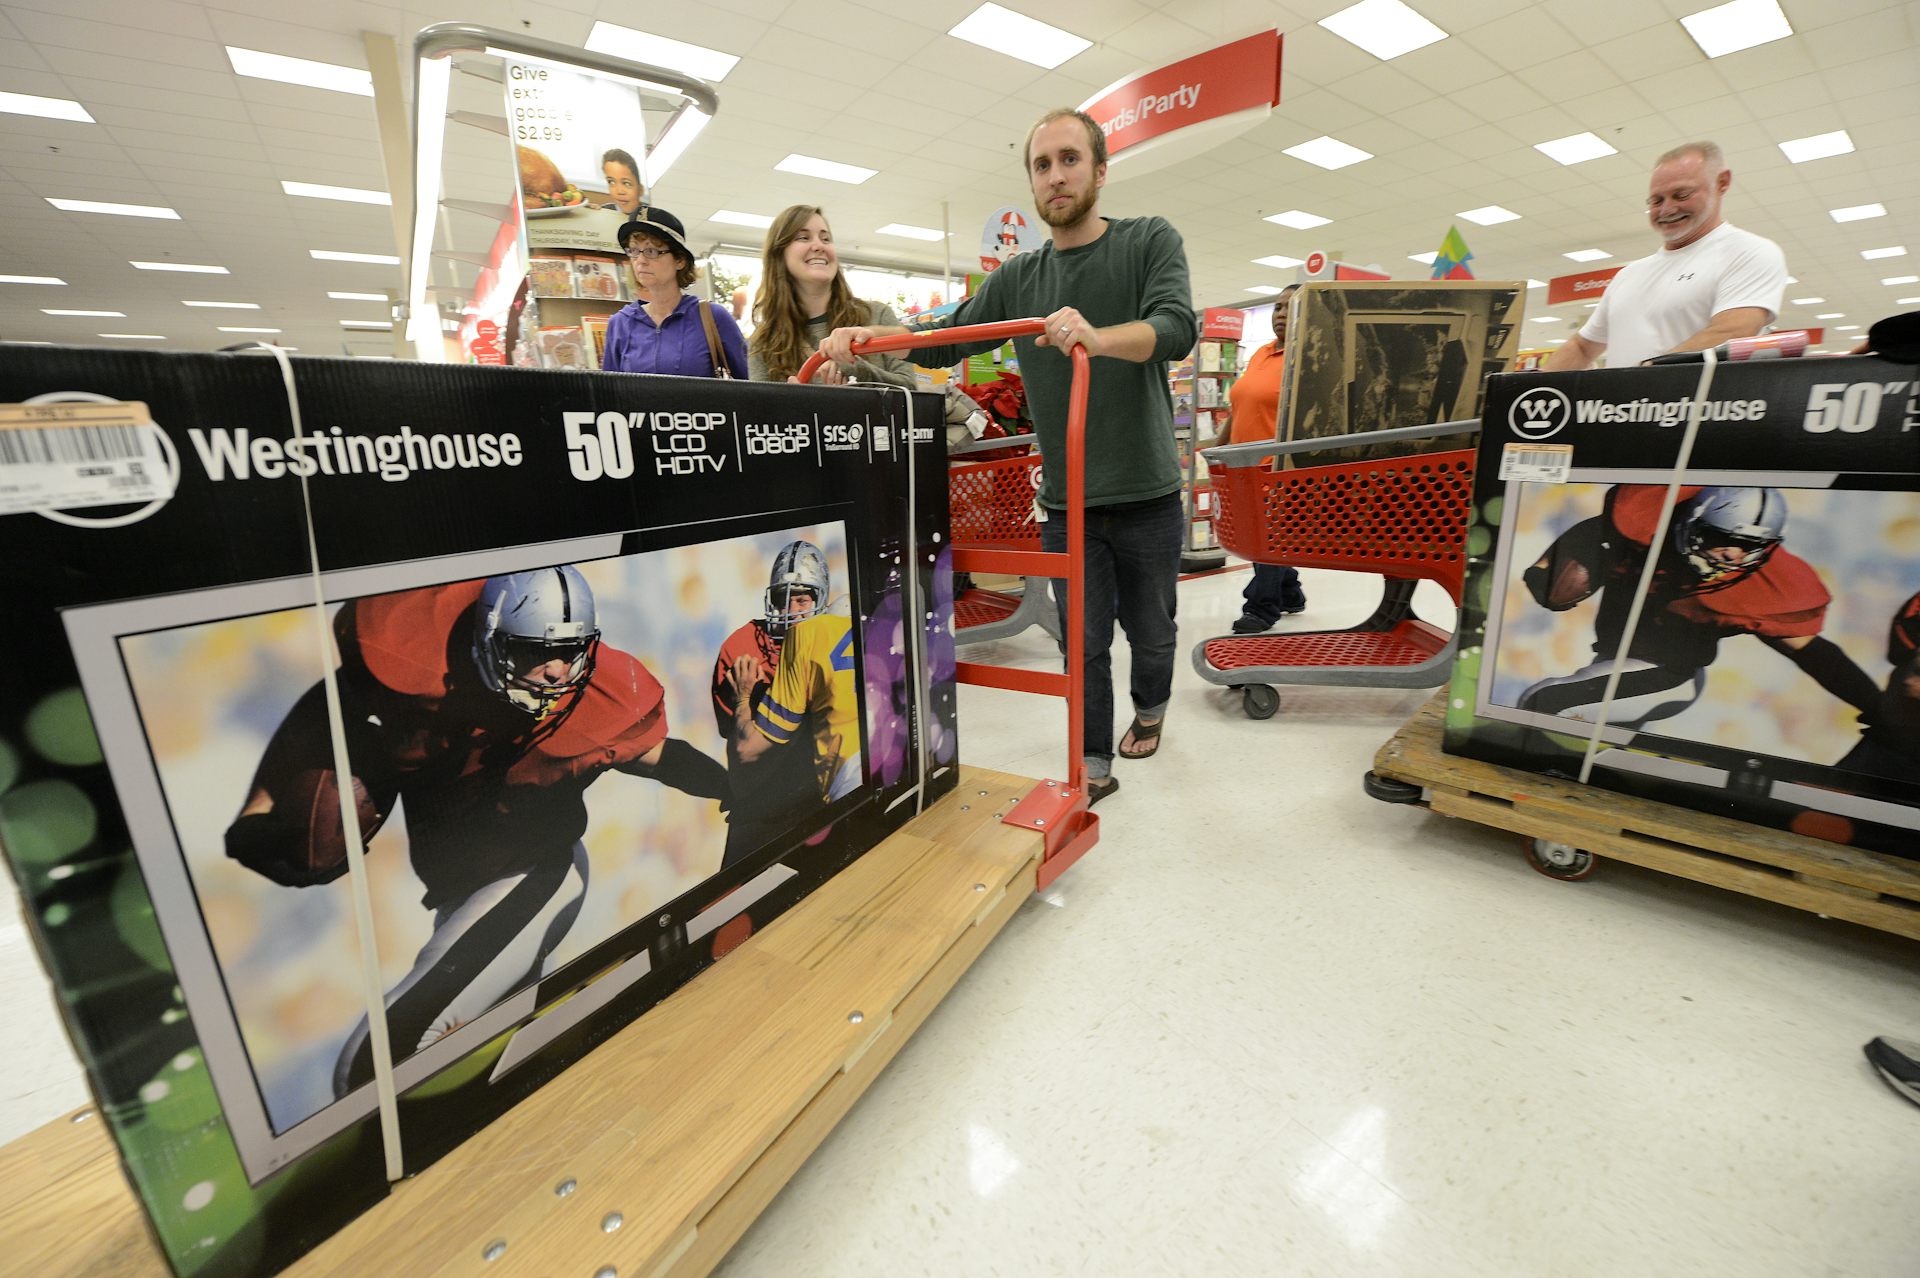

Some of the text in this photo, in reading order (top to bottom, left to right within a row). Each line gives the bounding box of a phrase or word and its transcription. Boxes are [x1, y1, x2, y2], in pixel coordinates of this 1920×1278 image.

[510, 65, 548, 80] Give
[1100, 83, 1202, 136] ards/Party
[517, 125, 563, 141] $2.99
[1573, 279, 1611, 292] Schoo
[649, 411, 727, 432] 1080P
[1575, 396, 1768, 428] Westinghouse
[187, 425, 523, 482] Westinghouse
[562, 410, 646, 481] 50"
[651, 433, 706, 454] LCD
[745, 436, 811, 455] 1080P
[655, 453, 727, 476] HDTV
